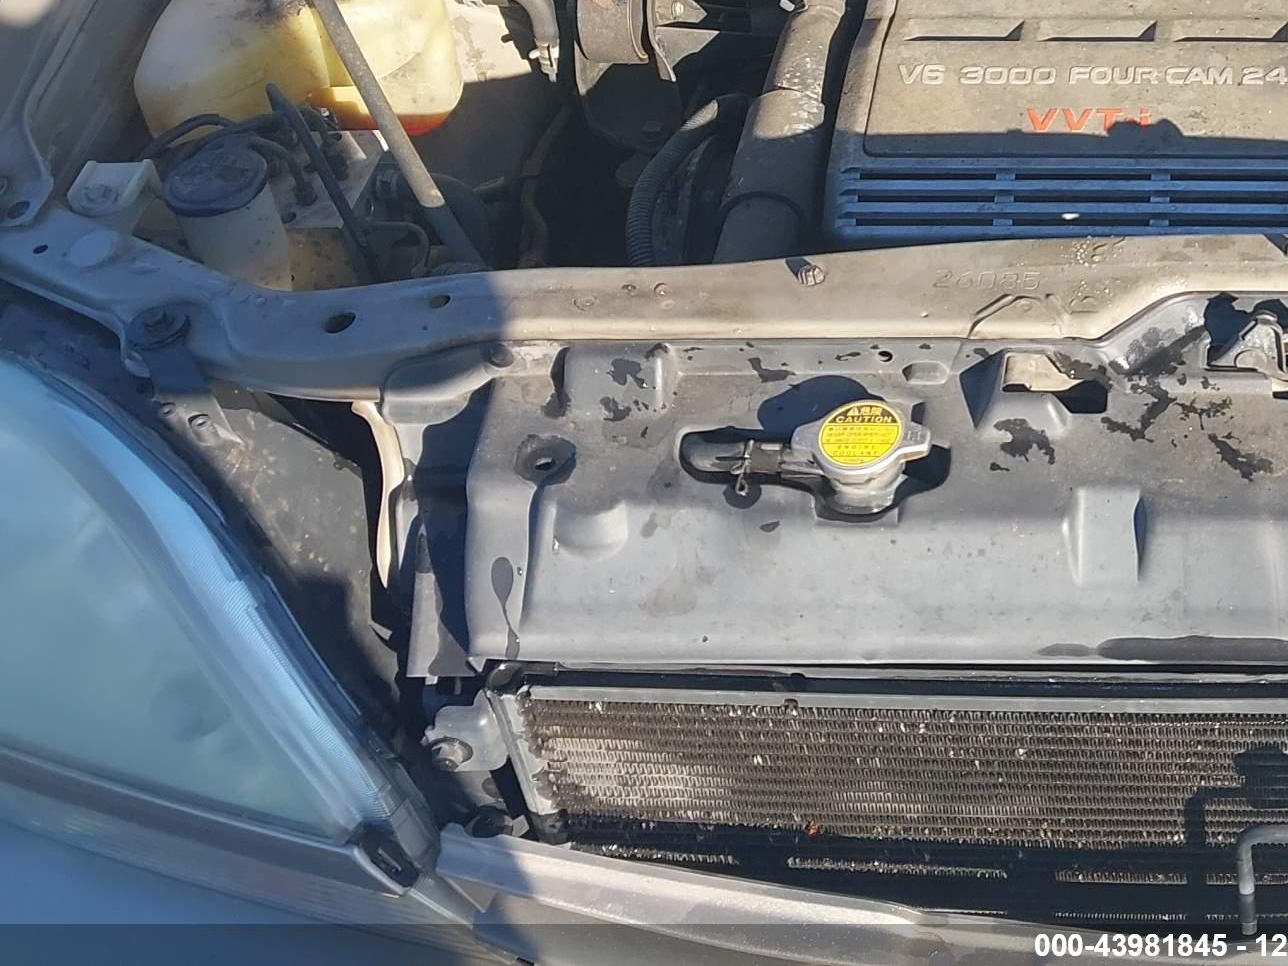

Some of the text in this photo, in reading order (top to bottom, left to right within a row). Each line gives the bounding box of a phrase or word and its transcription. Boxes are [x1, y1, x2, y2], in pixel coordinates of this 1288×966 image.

[897, 64, 1288, 85] V6 3000 FOUR CAM 24
[836, 416, 892, 424] CAUTION
